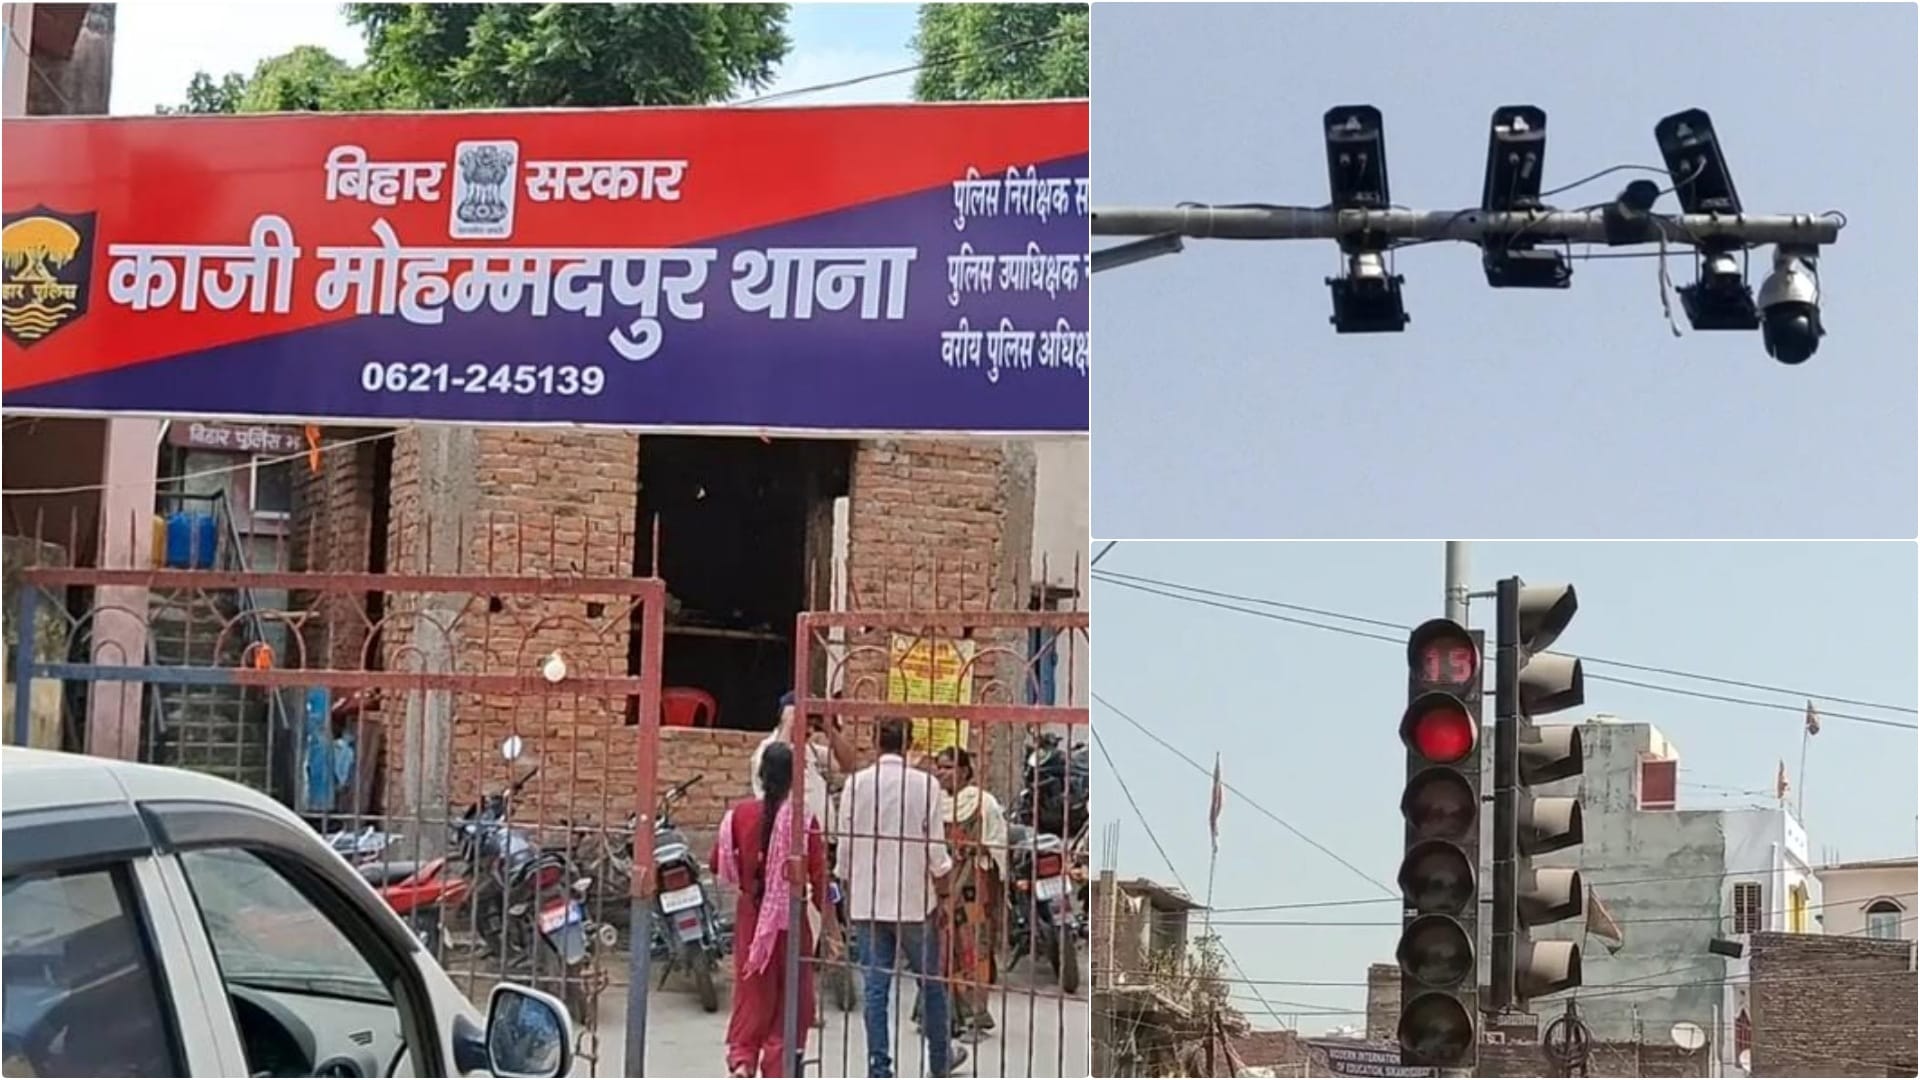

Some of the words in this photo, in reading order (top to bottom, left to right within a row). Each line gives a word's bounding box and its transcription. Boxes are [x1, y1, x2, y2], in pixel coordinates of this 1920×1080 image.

[325, 145, 447, 205] बिहार
[525, 160, 688, 201] सरकार
[953, 166, 1000, 231] पुलिस
[1005, 165, 1071, 223] निरीक्षक
[32, 280, 78, 305] पुलिस
[108, 214, 301, 313] काजी
[316, 217, 717, 361] मोहम्मदपुर
[730, 247, 917, 320] थाना
[947, 242, 995, 306] पुलिस
[999, 241, 1080, 300] उपाधिक्षक
[361, 361, 605, 395] 0621-245139
[941, 317, 983, 368] वरीय
[987, 318, 1035, 382] पुलिस
[189, 423, 230, 446] बिहार
[235, 426, 282, 450] पुलिस
[1425, 647, 1472, 682] 15
